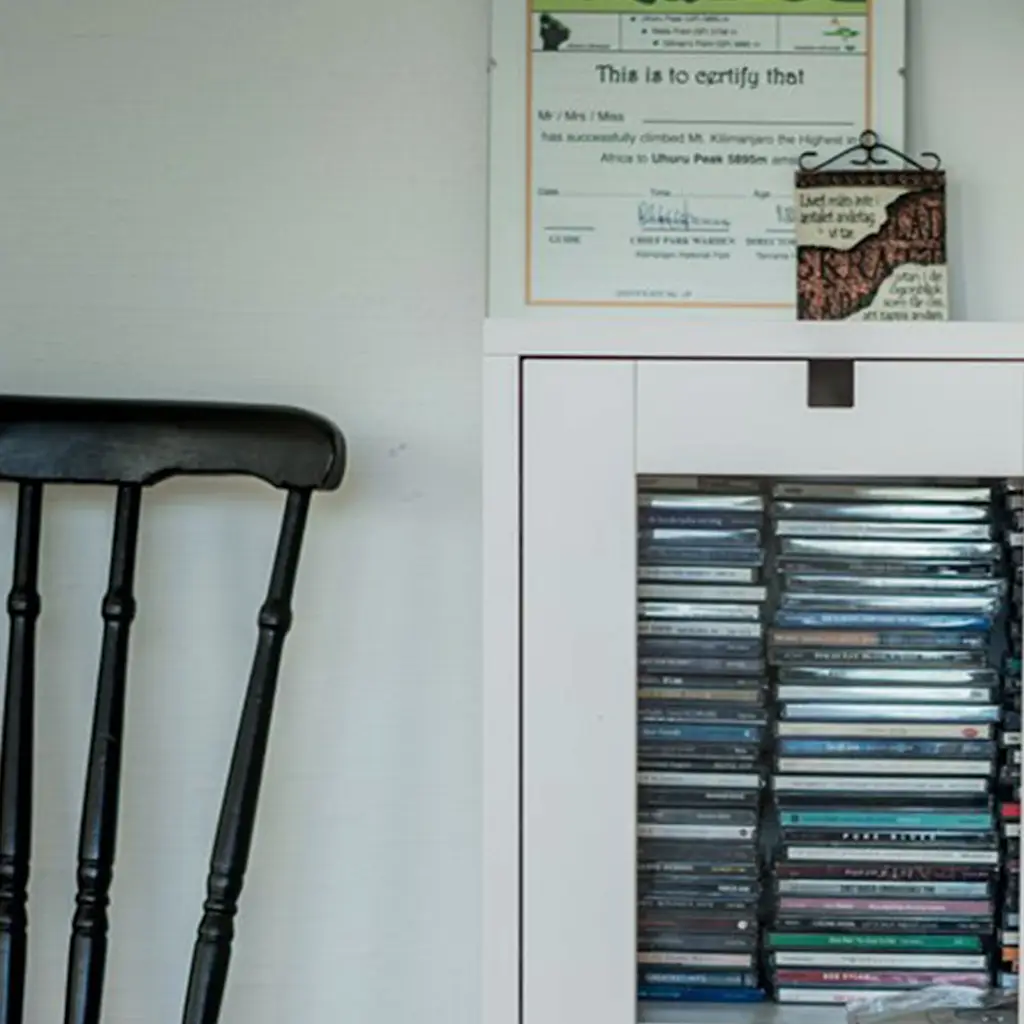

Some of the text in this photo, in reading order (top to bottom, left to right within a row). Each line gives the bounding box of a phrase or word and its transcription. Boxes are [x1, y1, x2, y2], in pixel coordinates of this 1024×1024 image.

[596, 64, 804, 89] This is to certify that
[538, 110, 553, 121] Mr
[565, 111, 586, 121] Mrs
[598, 111, 624, 121] Miss
[541, 131, 562, 142] has
[567, 132, 636, 147] successfully
[640, 132, 685, 143] climbed
[710, 134, 774, 146] Kilimanjaro
[778, 135, 796, 144] the
[600, 152, 633, 162] Africa
[637, 154, 648, 162] to
[652, 153, 690, 164] Uhuru
[694, 154, 723, 164] Peak
